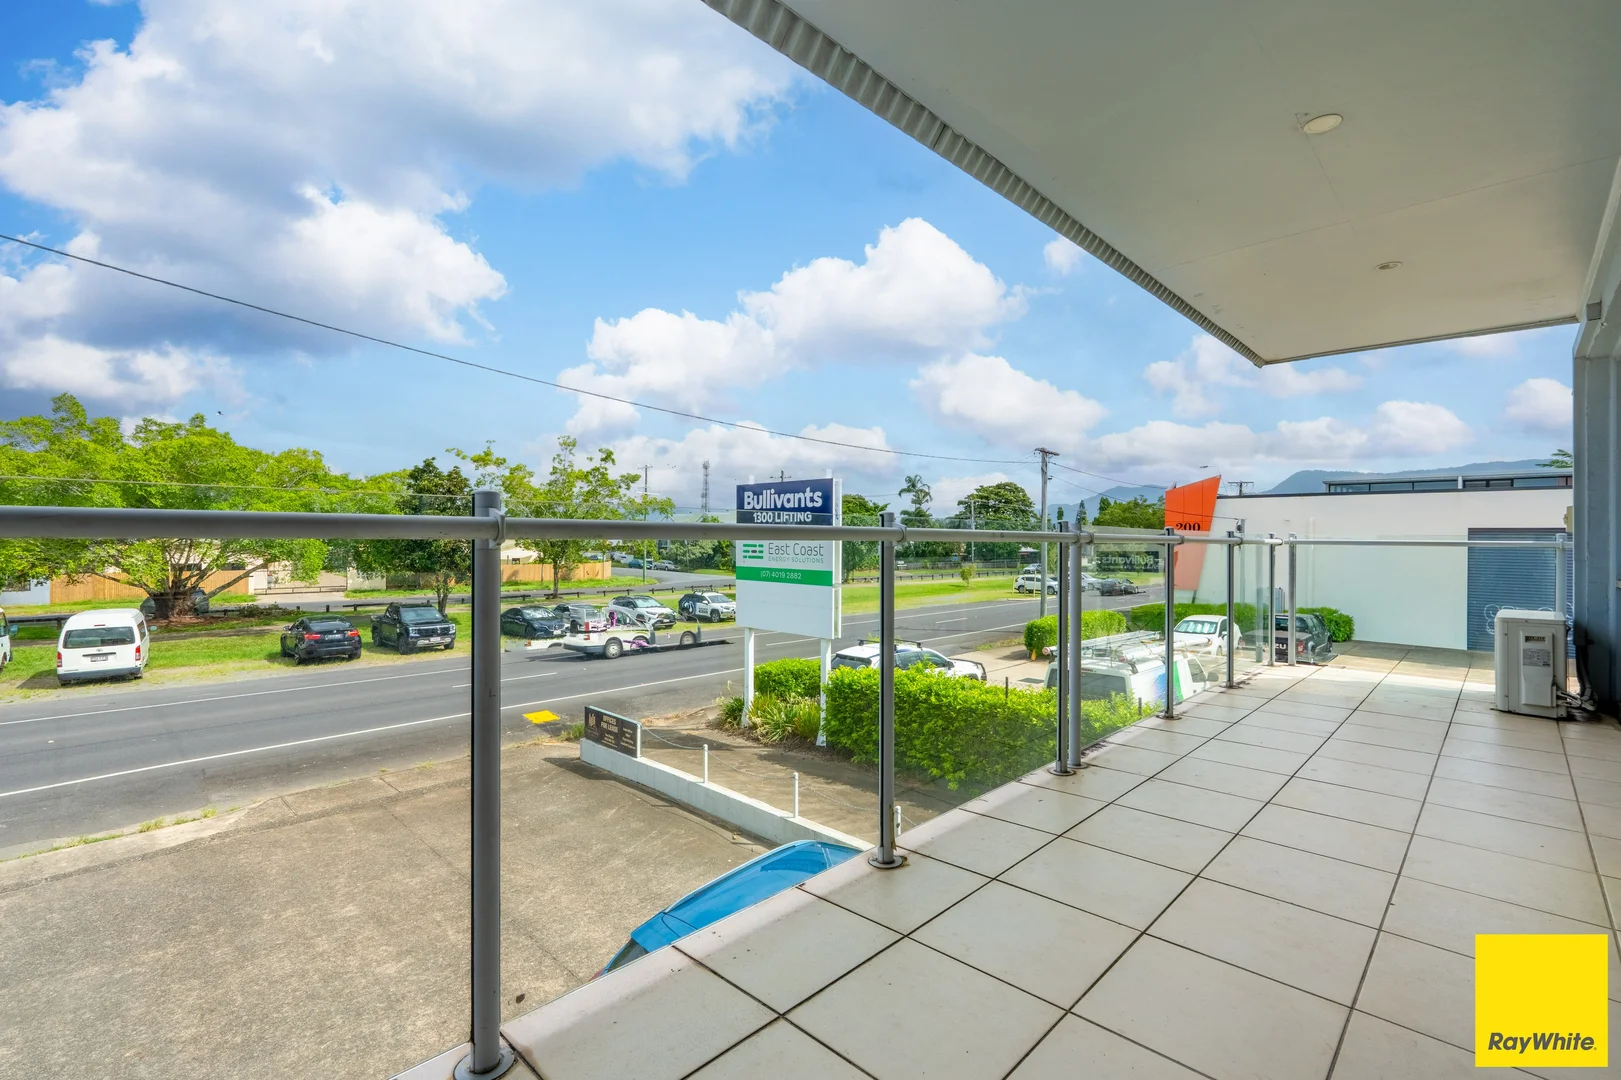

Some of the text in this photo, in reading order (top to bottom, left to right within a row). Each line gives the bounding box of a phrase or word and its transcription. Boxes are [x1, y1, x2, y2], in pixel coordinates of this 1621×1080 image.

[744, 487, 823, 510] Bullivants
[753, 511, 812, 523] 1300 LIFTING
[1176, 522, 1201, 531] 200
[768, 542, 824, 557] East Coast
[768, 555, 824, 564] ENERGY SOLUTIONS
[760, 570, 802, 580] (07) 4019 2882
